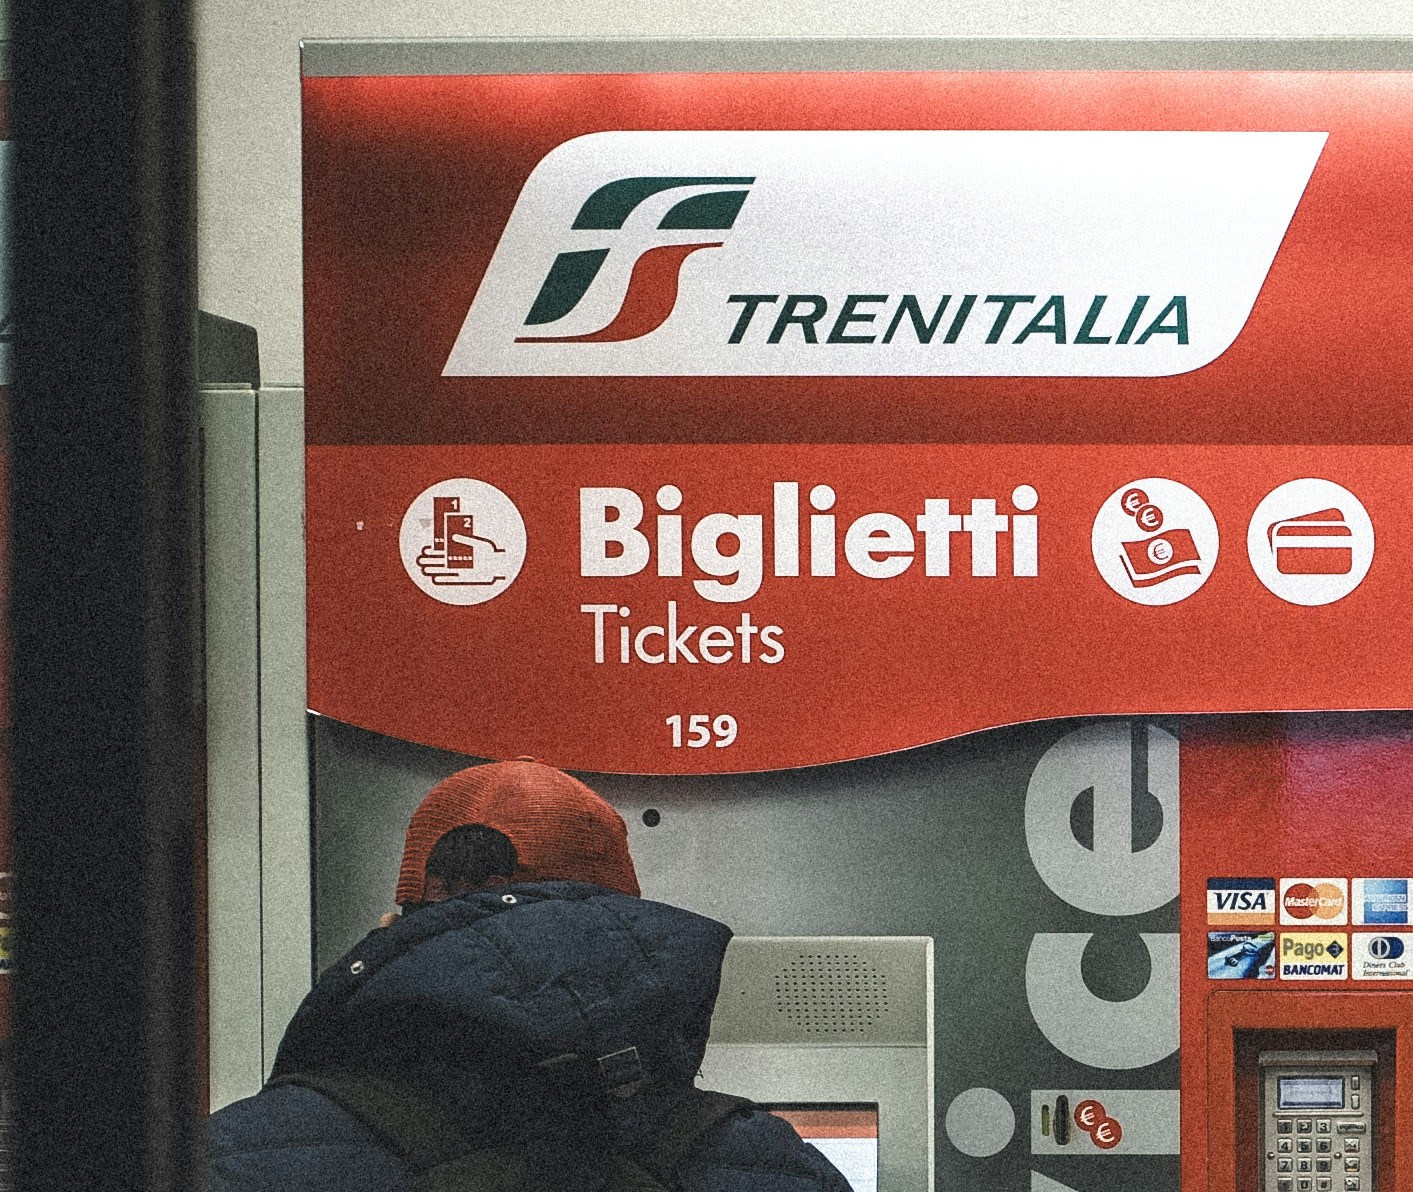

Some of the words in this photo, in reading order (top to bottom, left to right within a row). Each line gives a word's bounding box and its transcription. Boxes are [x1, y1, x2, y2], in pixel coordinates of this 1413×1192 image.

[726, 294, 1190, 346] TRENITALIA
[578, 482, 1040, 606] Biglietti
[581, 601, 786, 666] Tickets
[665, 714, 738, 749] 159
[1215, 892, 1270, 911] VISA
[1285, 896, 1344, 907] MasterCard
[1283, 938, 1324, 960] Pago
[1283, 964, 1345, 976] BANCOMAT
[1319, 1122, 1328, 1131] 3
[1280, 1141, 1289, 1151] 4
[1281, 1160, 1289, 1170] 7
